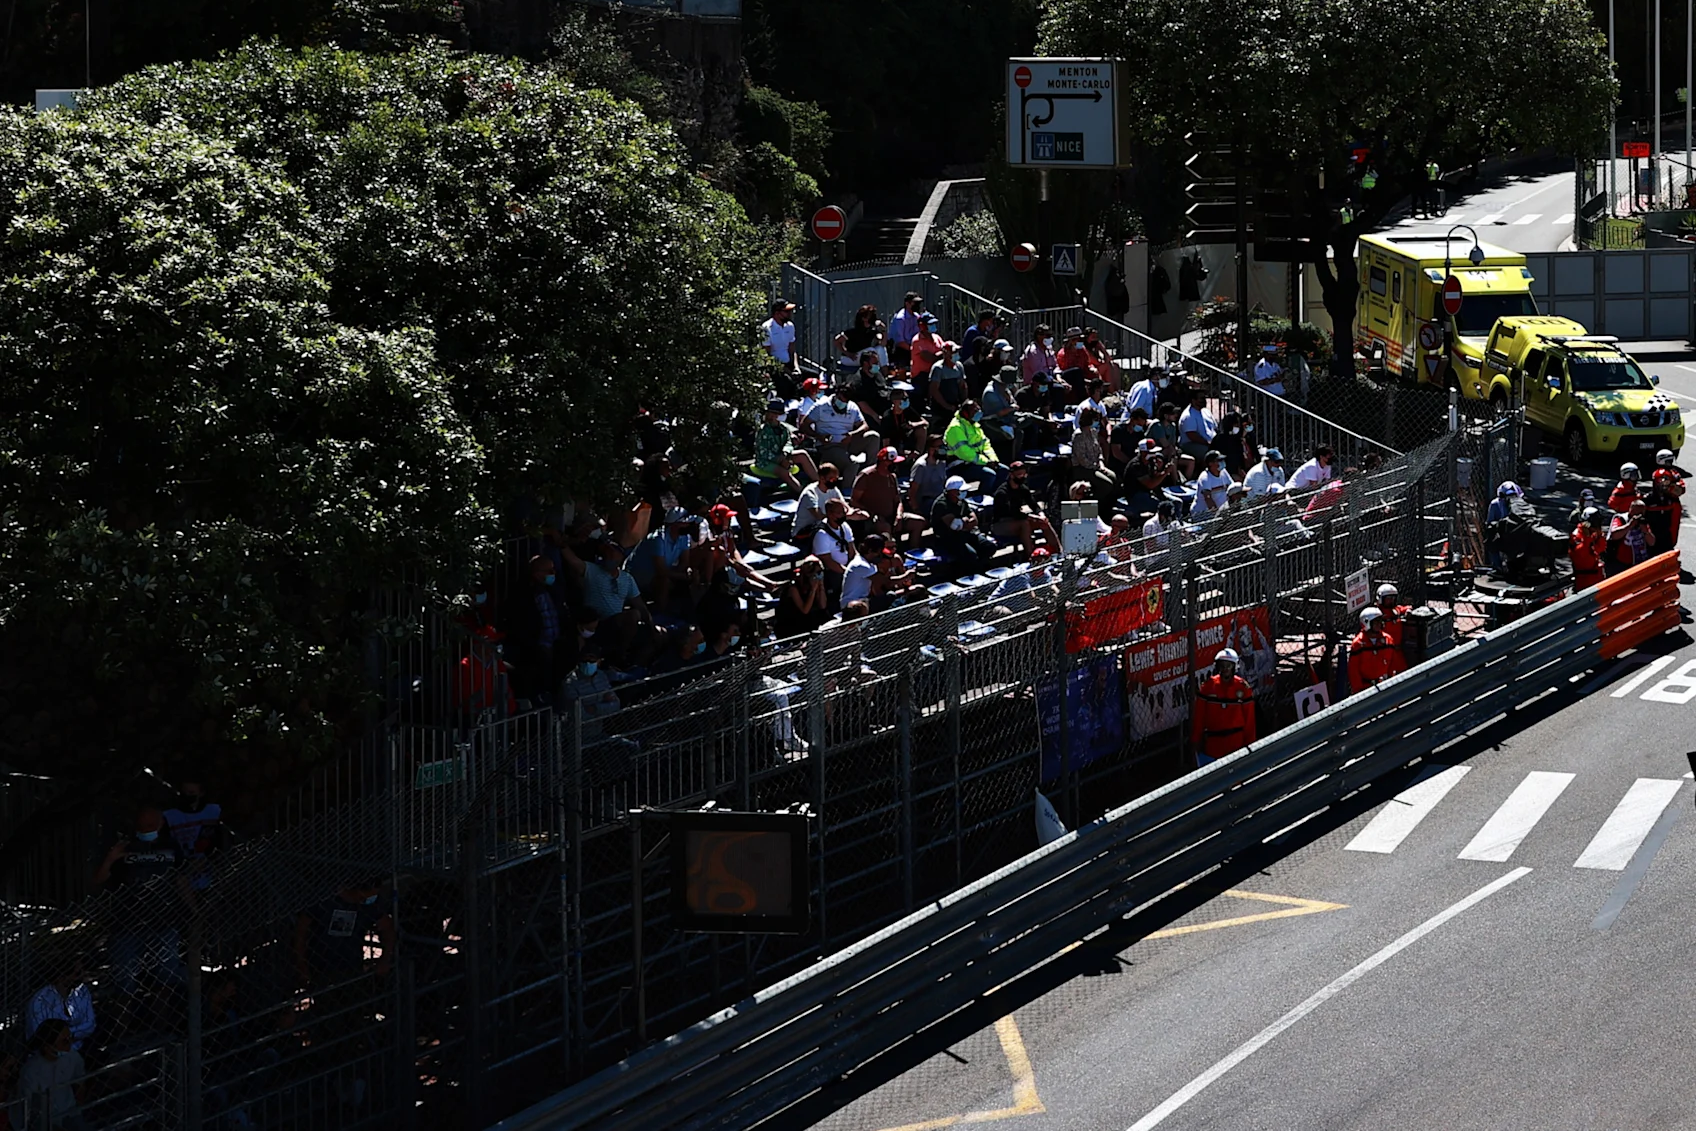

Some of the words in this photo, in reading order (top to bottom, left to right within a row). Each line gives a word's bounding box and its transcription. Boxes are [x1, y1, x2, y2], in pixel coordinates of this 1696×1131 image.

[1058, 67, 1098, 77] MENTON
[1056, 141, 1082, 154] NICE
[1128, 646, 1156, 674] Lewis
[1195, 624, 1225, 650] France
